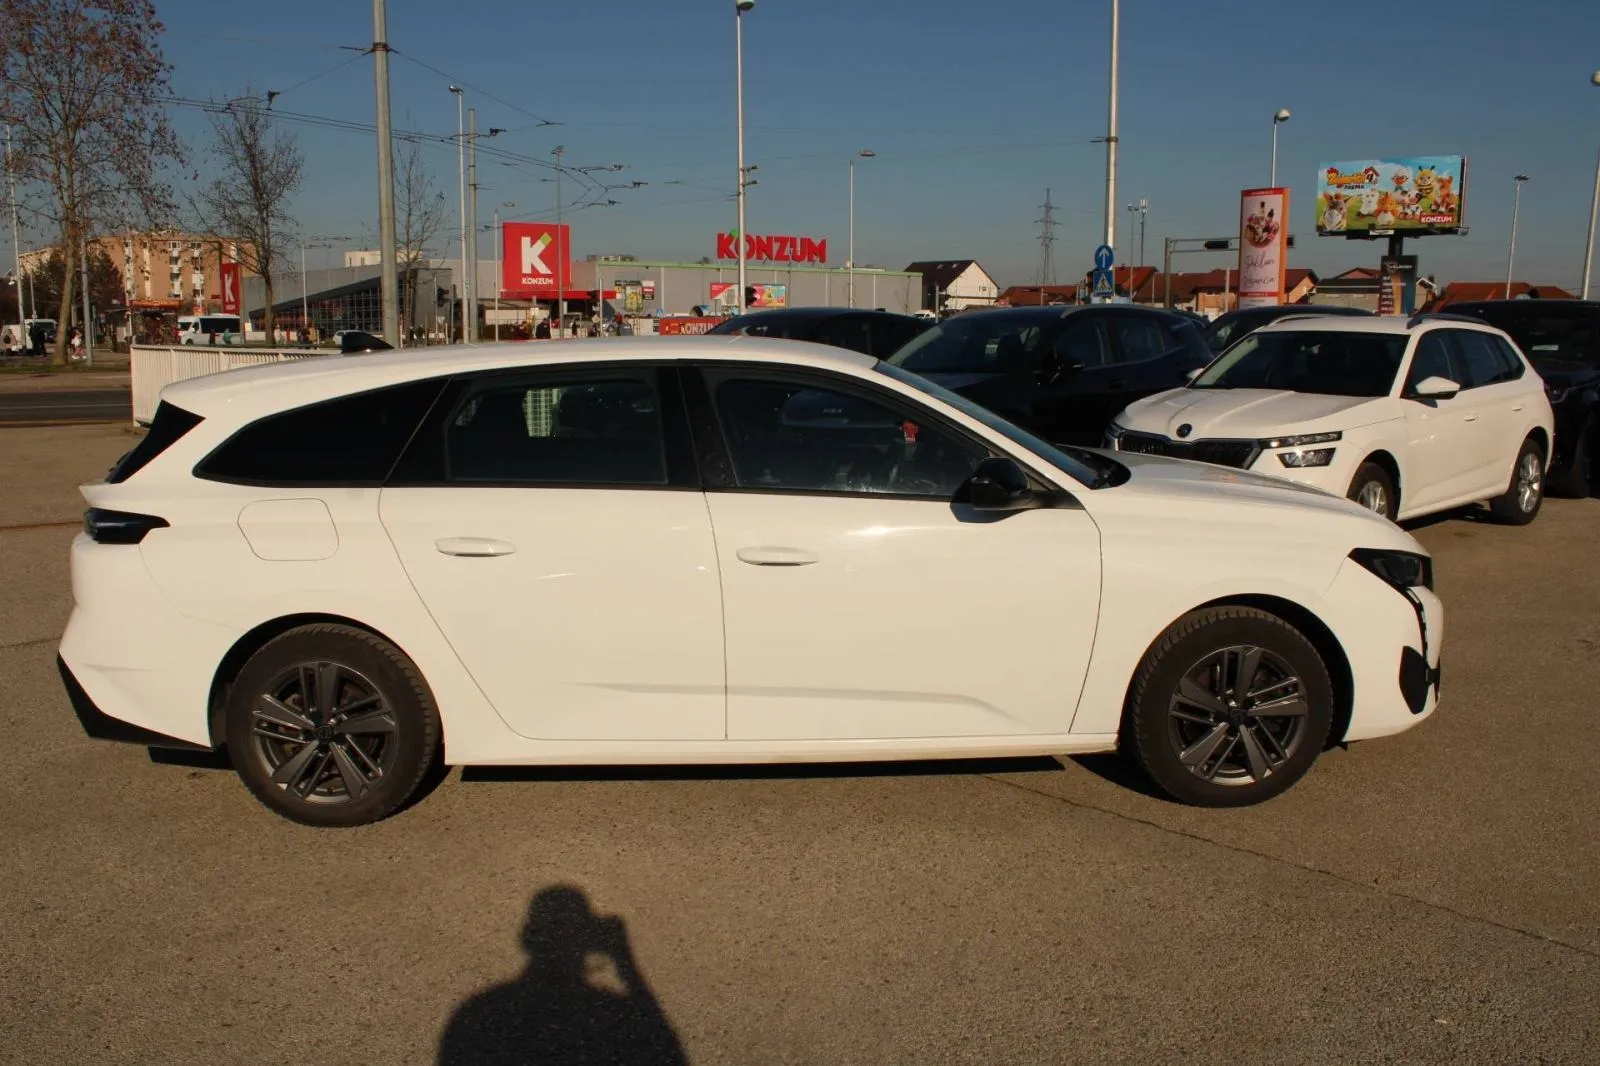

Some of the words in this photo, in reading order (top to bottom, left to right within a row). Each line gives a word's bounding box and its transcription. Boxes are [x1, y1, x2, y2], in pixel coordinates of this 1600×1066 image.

[521, 232, 553, 275] K
[717, 228, 827, 264] KONZUM
[521, 276, 554, 285] KONZUM
